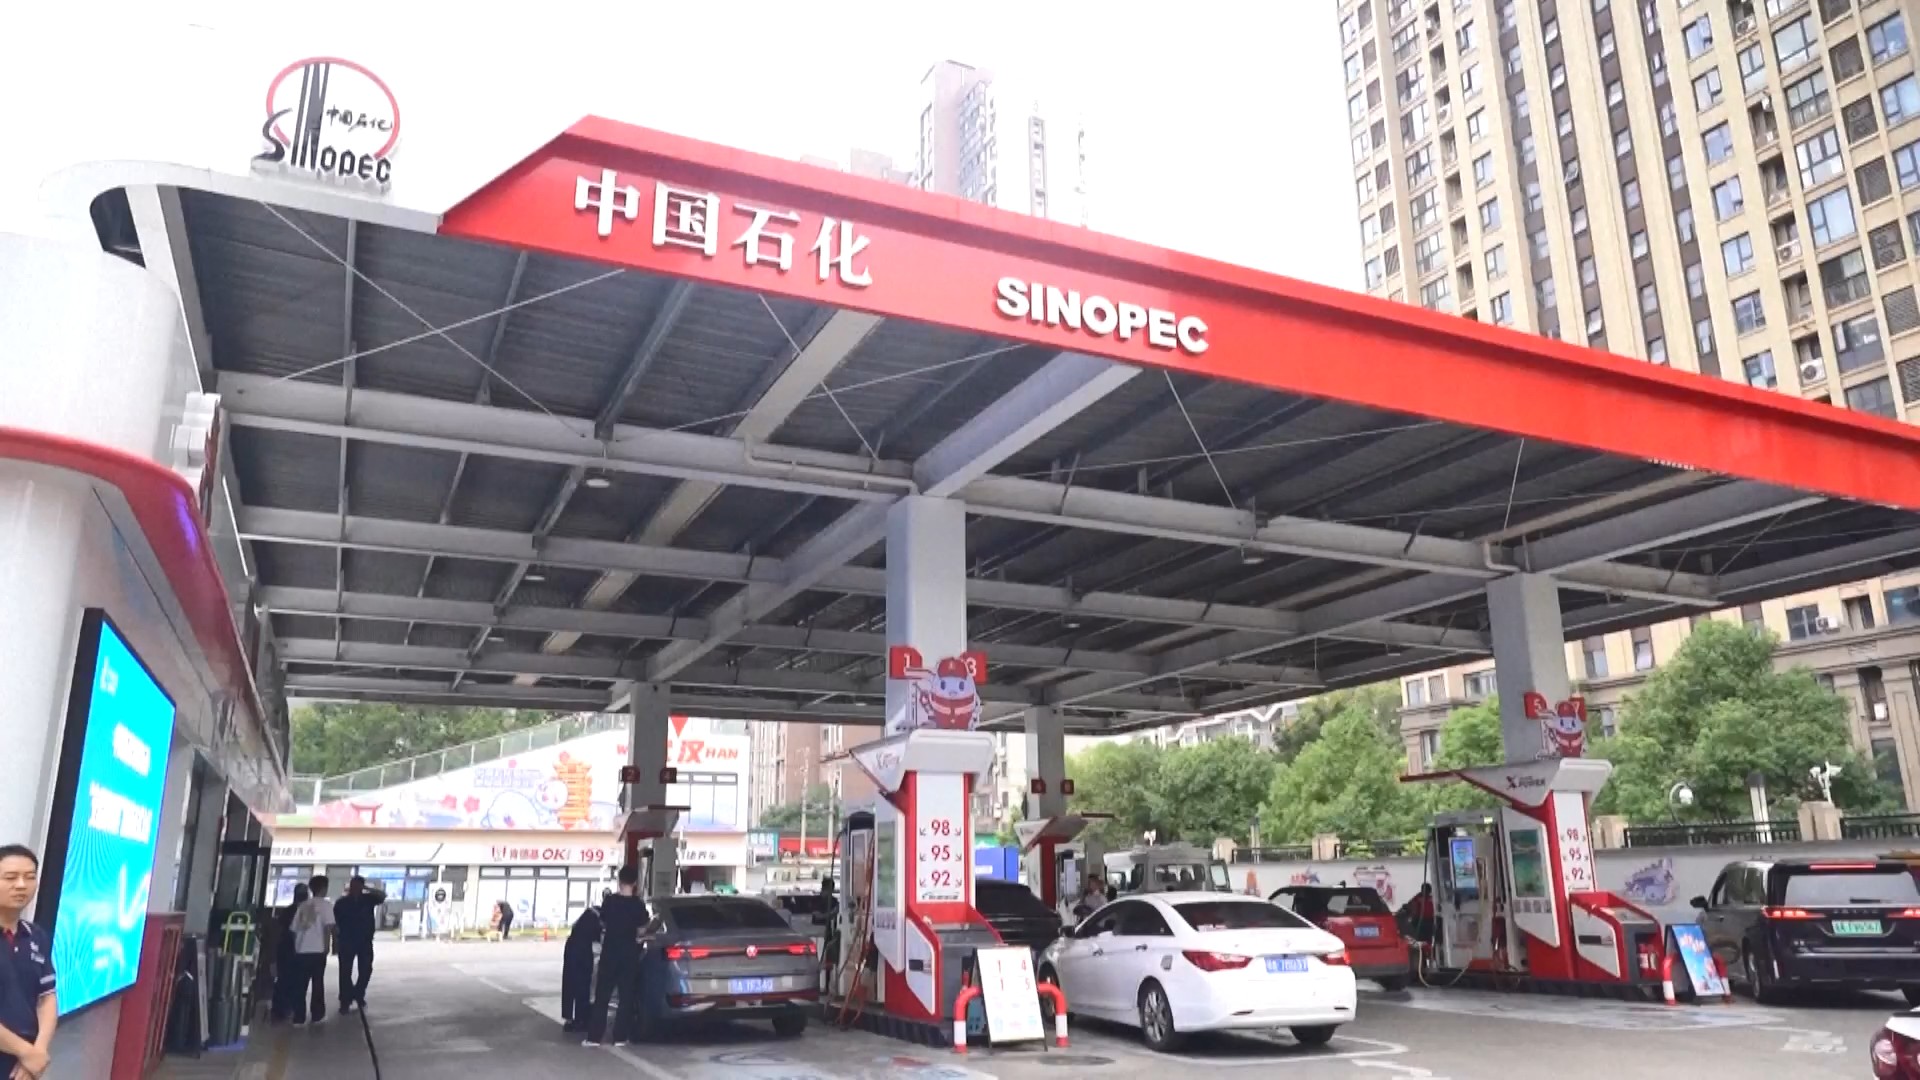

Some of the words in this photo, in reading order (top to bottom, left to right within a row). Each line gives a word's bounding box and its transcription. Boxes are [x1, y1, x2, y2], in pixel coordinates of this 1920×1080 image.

[574, 168, 874, 287] 中国石化
[997, 276, 1210, 354] SINOPEC
[966, 657, 977, 677] 3
[704, 747, 739, 759] HAN
[931, 819, 951, 836] 98
[1567, 828, 1579, 840] 98
[931, 845, 951, 861] 95
[1569, 848, 1582, 860] 95
[931, 870, 951, 887] 92
[1571, 868, 1584, 880] 92
